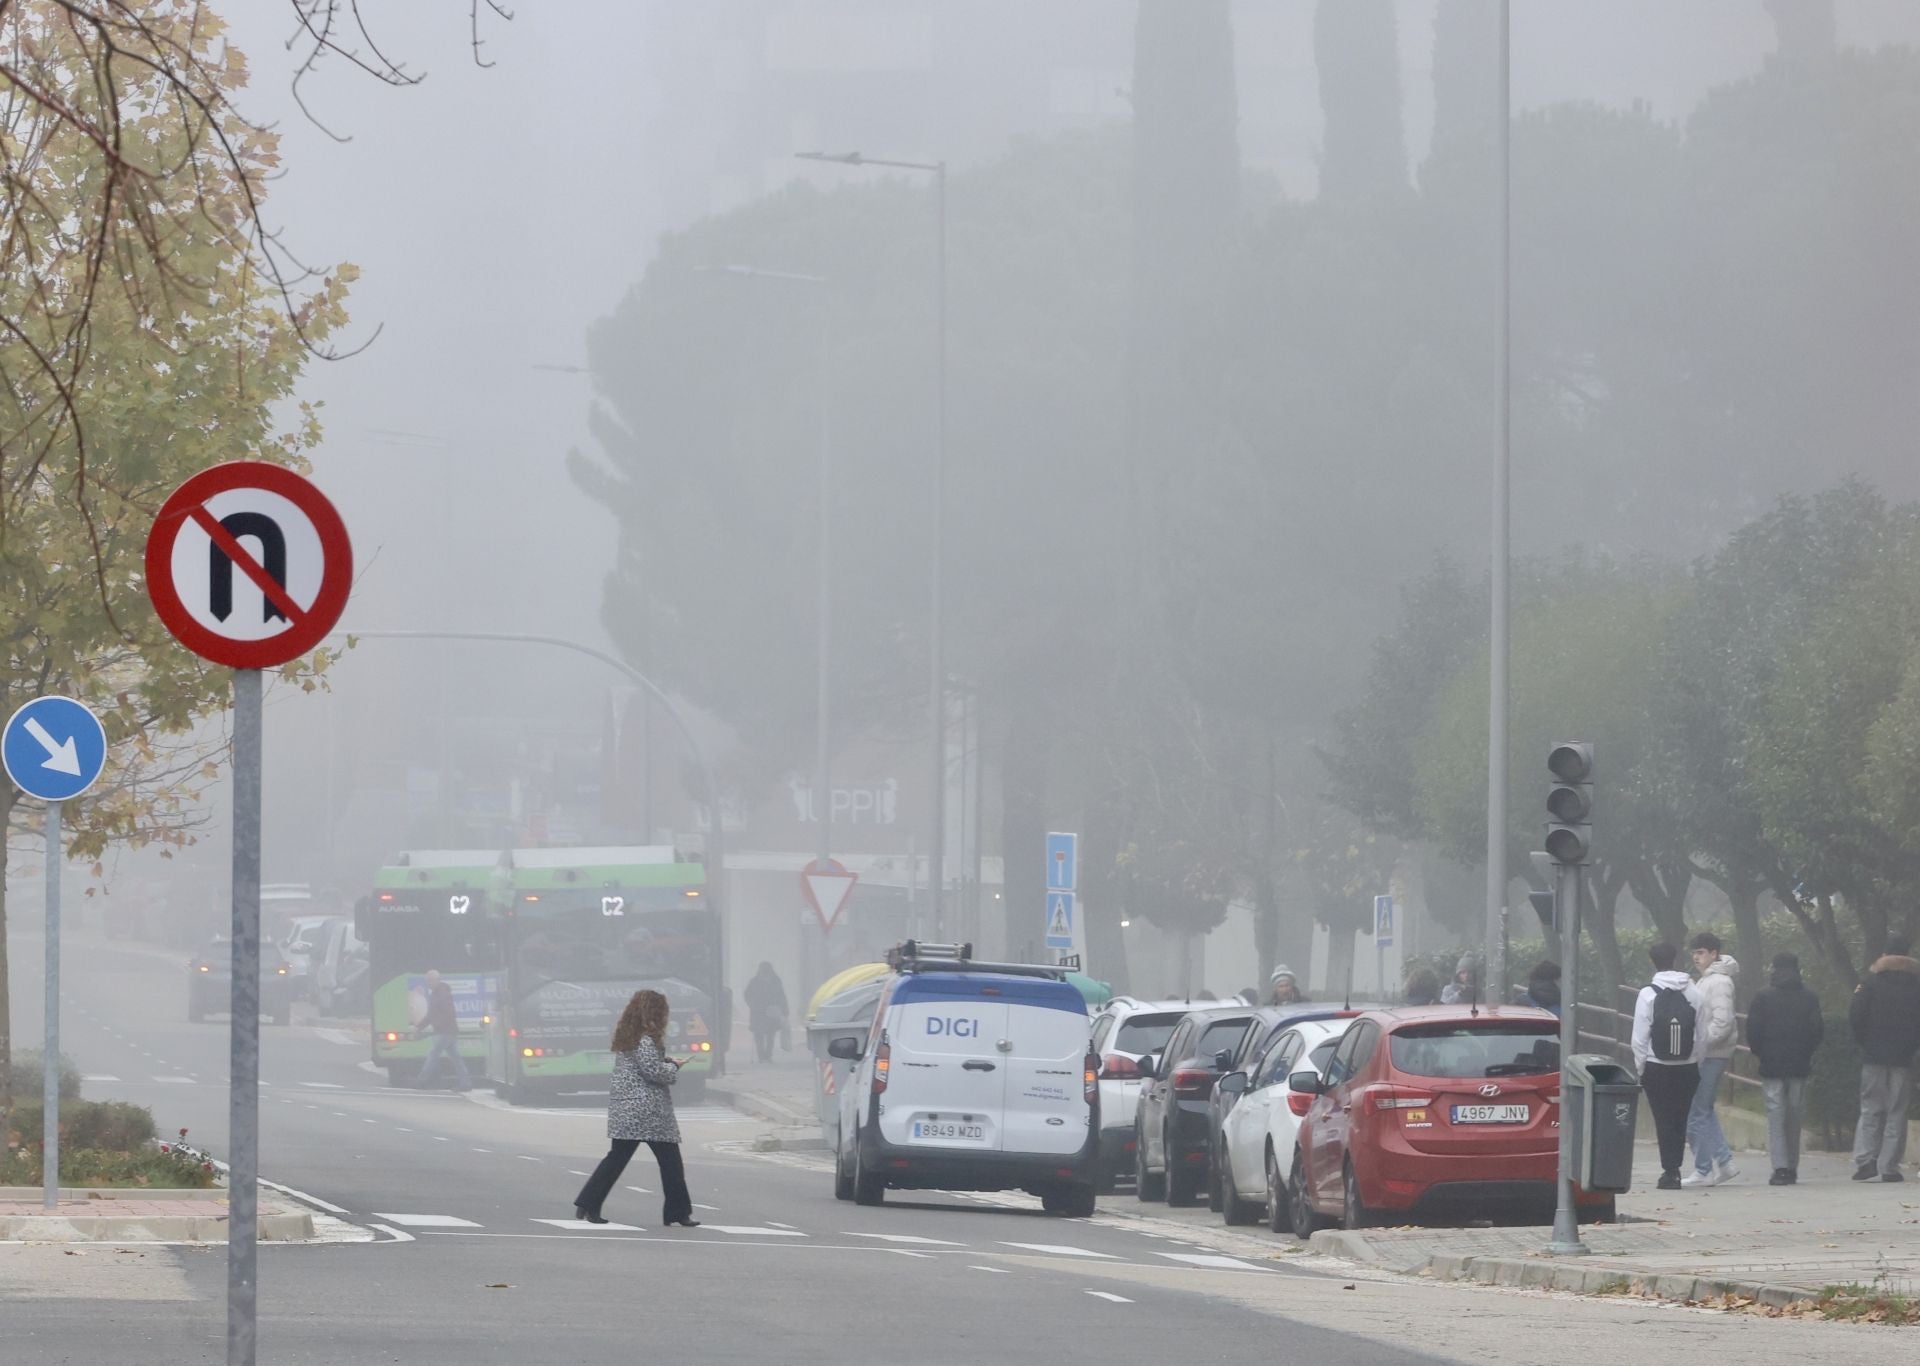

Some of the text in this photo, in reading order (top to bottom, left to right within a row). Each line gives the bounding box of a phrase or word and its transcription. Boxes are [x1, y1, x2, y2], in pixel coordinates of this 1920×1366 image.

[601, 896, 625, 916] C2
[926, 1016, 978, 1038] DIGI
[1460, 1106, 1526, 1120] 4967 JNV
[922, 1124, 982, 1138] 8949 MZD
